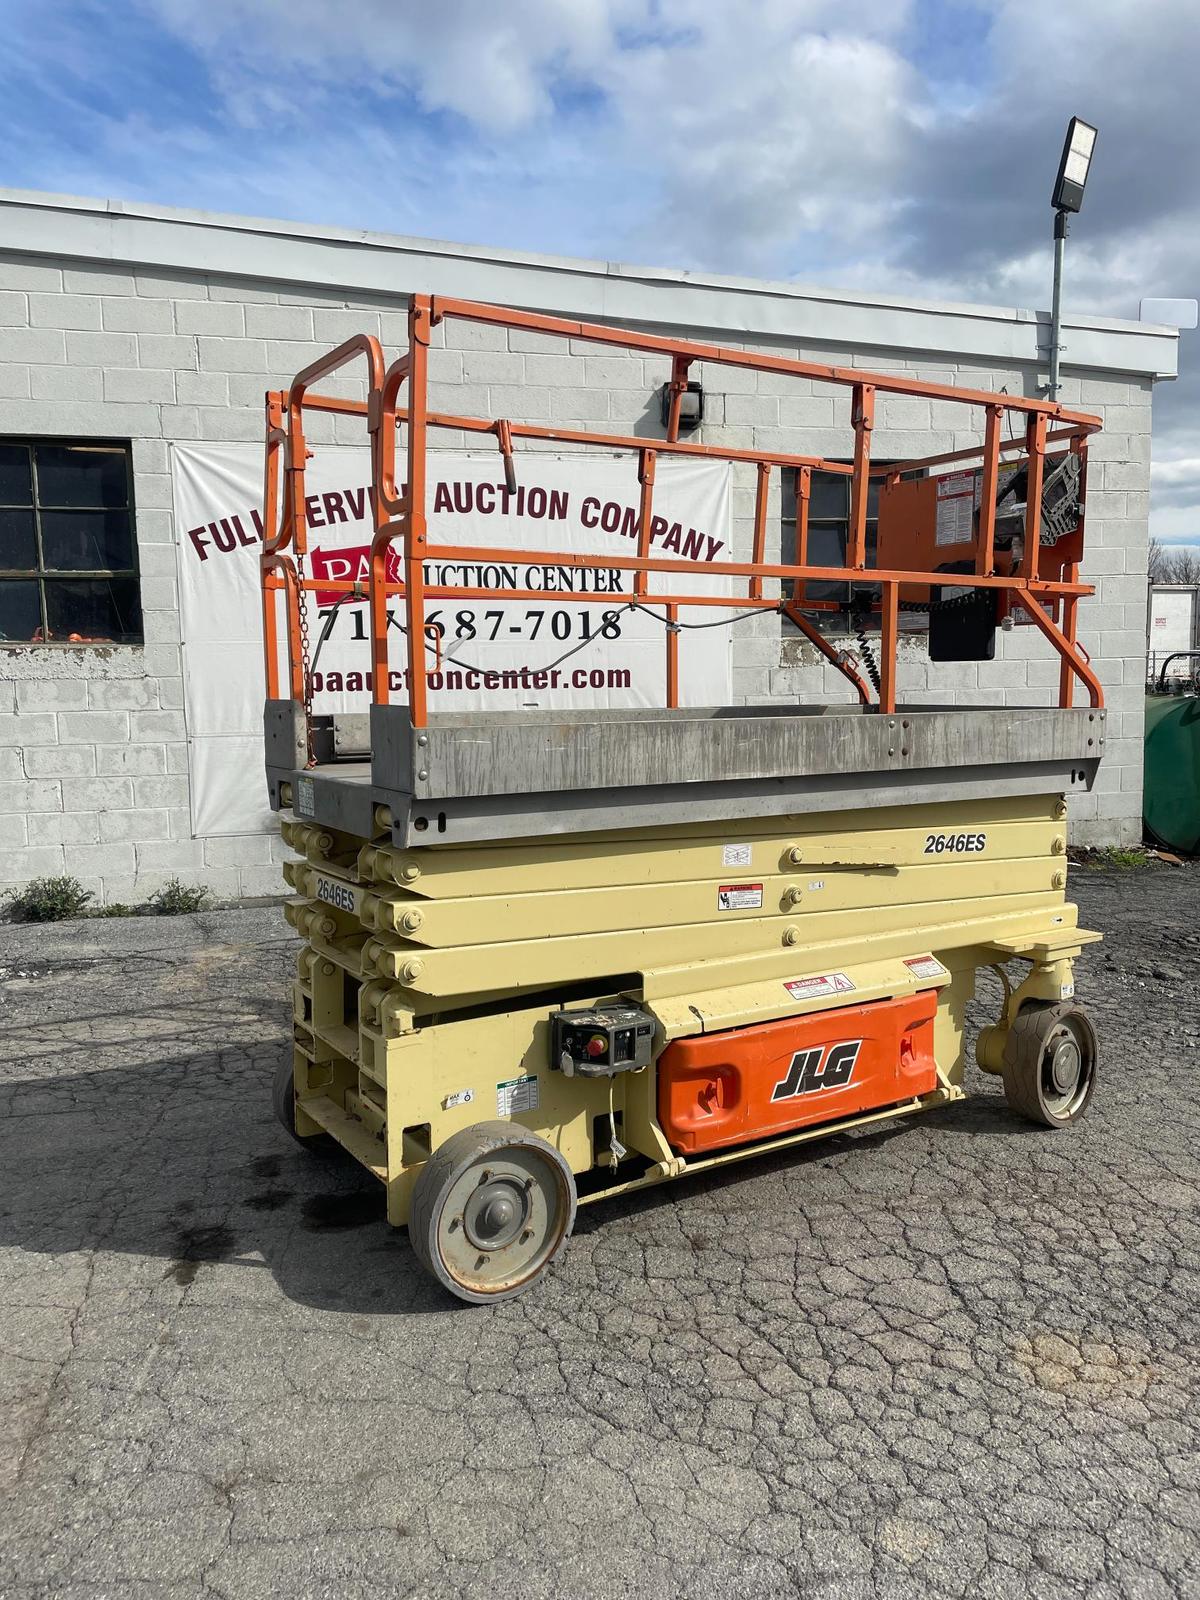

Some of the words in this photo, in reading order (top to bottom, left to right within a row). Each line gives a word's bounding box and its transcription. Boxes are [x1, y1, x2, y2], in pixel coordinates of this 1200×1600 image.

[433, 482, 569, 520] AUCTION
[580, 496, 725, 562] COMPANY
[422, 565, 518, 590] UCTION
[525, 566, 624, 592] CENTER
[924, 834, 986, 853] 2646ES
[317, 878, 355, 912] 2646ES
[771, 1041, 861, 1101] JLG
